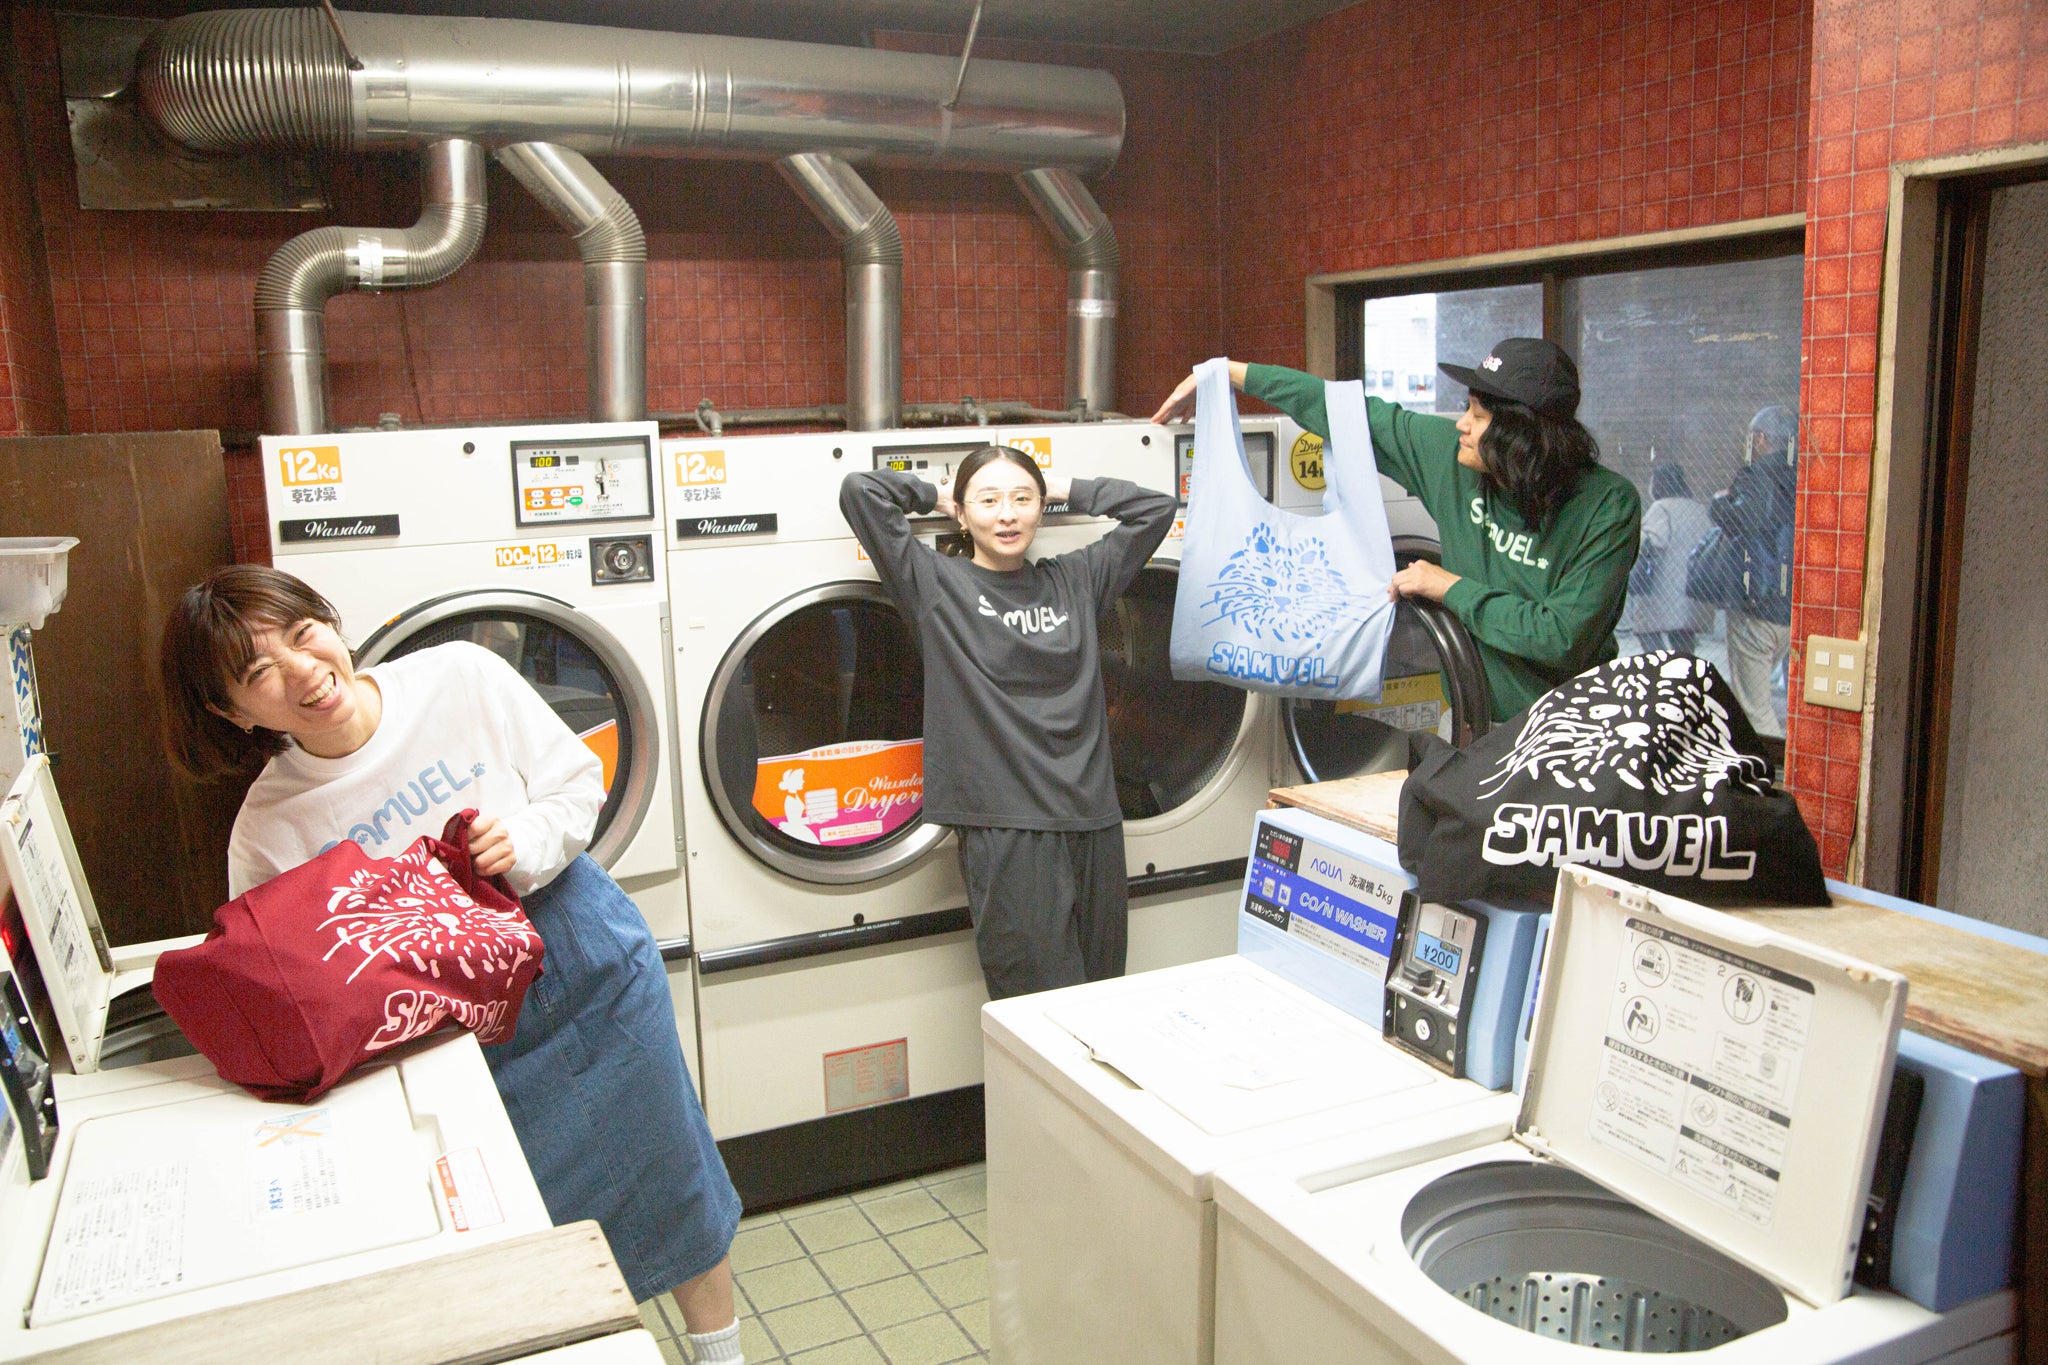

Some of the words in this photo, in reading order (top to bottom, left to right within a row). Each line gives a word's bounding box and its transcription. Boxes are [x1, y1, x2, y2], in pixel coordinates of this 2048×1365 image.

[283, 450, 340, 482] 12Kg
[535, 457, 553, 467] 100
[677, 453, 725, 484] 12Kg
[291, 487, 337, 504] 乾燥
[683, 487, 722, 502] 乾燥
[305, 520, 377, 538] Wassalon
[697, 518, 759, 535] Wassalon
[978, 594, 1068, 635] SMUEL
[1207, 641, 1338, 689] SAMUEL
[319, 760, 473, 856] AMUEL
[843, 786, 923, 819] Dryer
[1482, 803, 1757, 881] SAMUEL
[1310, 858, 1343, 882] AQUA
[1349, 873, 1375, 895] 洗濯機
[1375, 884, 1394, 905] 5kg
[1335, 907, 1388, 943] WASHER
[1424, 943, 1454, 969] ¥200
